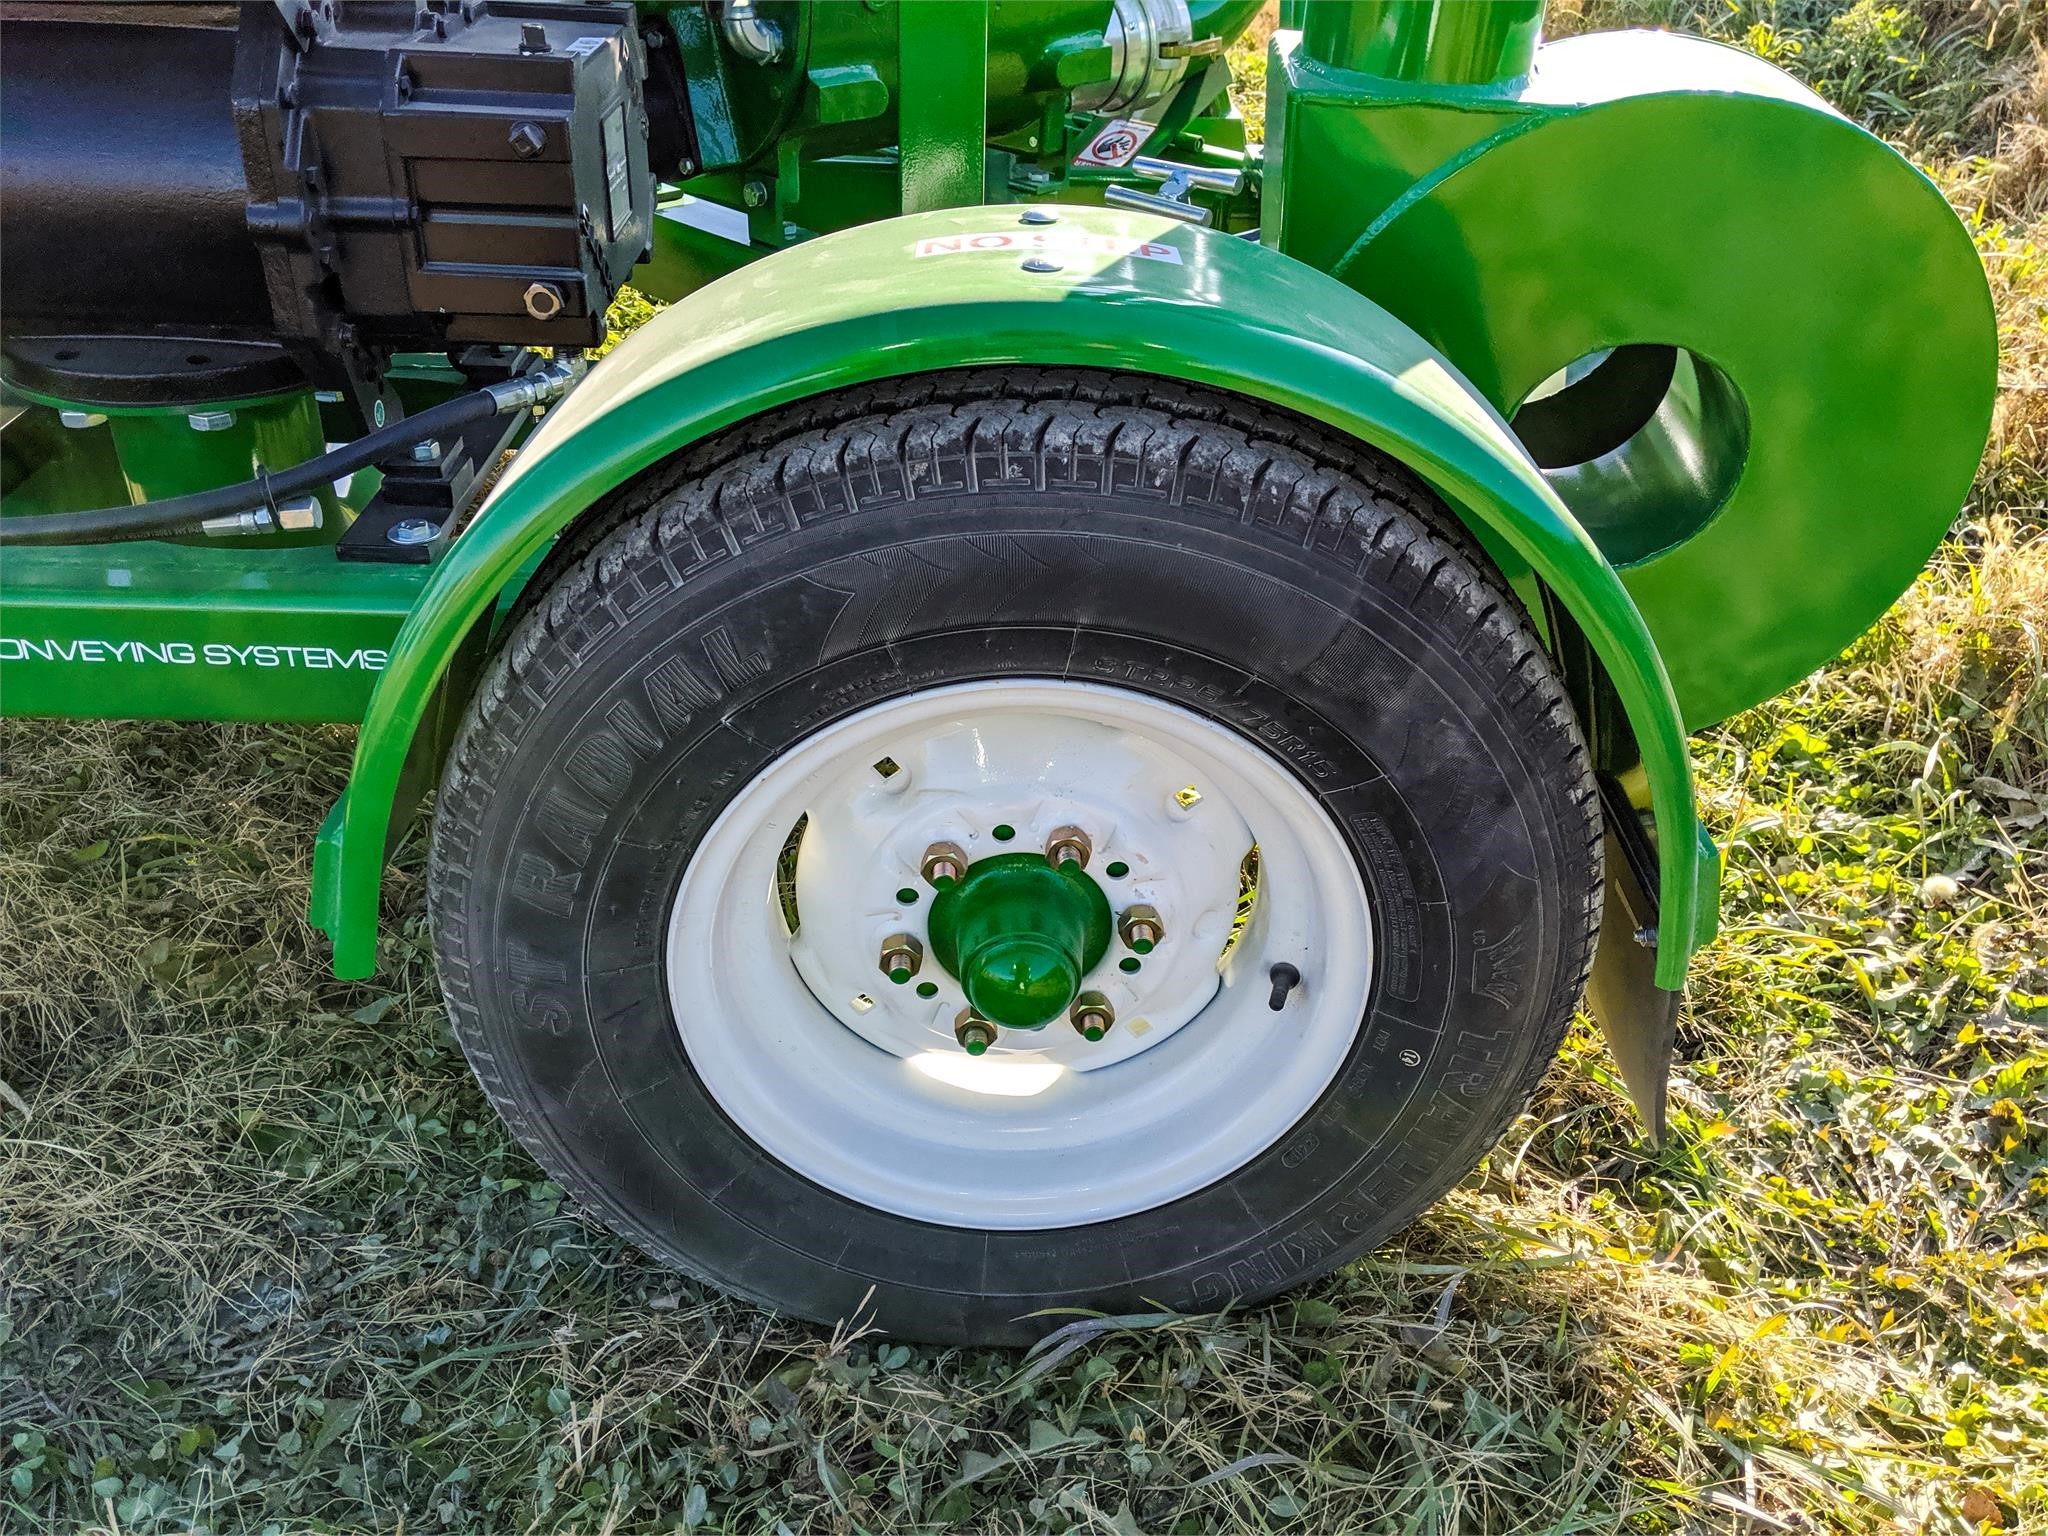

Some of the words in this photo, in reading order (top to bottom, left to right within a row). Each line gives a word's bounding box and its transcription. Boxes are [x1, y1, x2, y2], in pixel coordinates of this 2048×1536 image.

[924, 235, 1012, 254] NO
[203, 643, 388, 671] SYSTEMS
[511, 625, 770, 919] RADIAL
[507, 934, 574, 1038] ST
